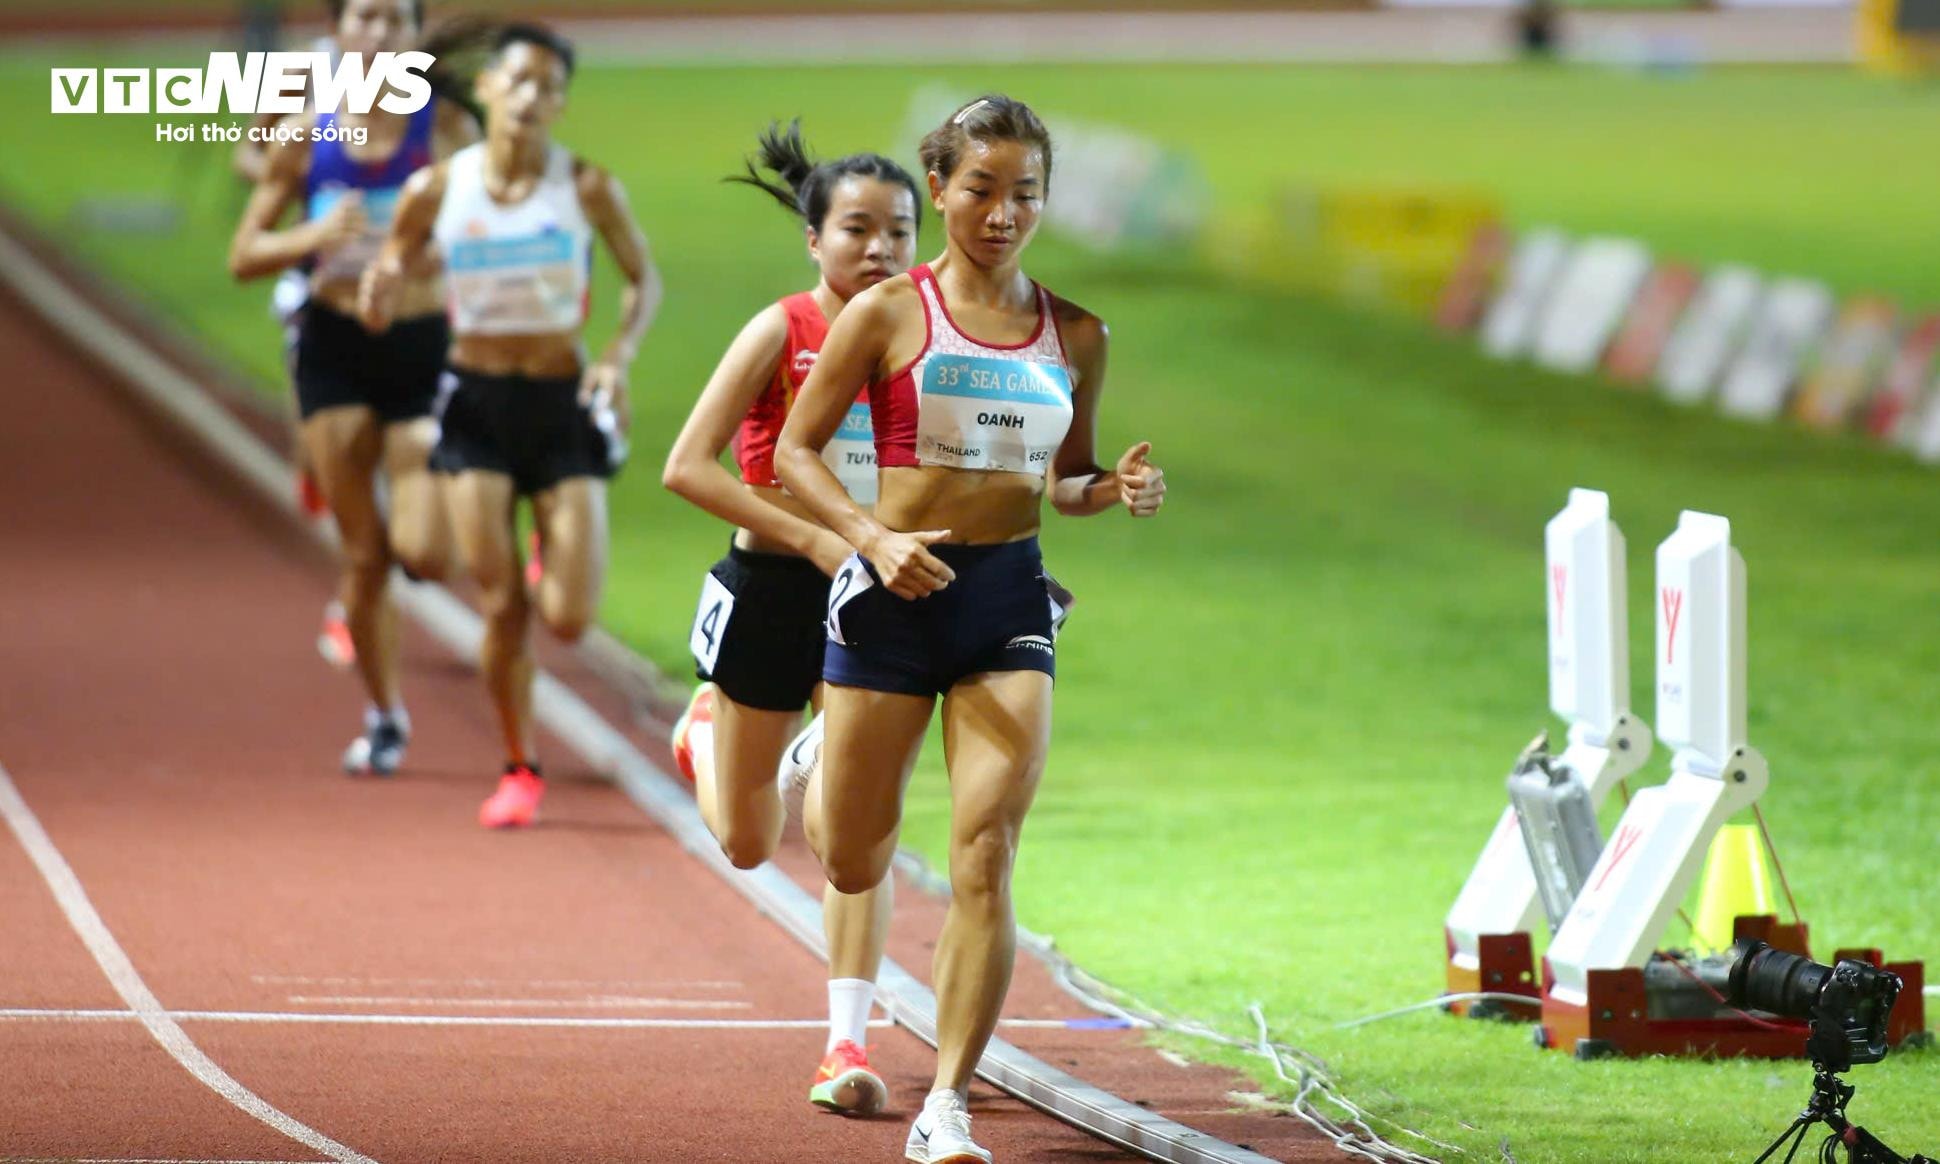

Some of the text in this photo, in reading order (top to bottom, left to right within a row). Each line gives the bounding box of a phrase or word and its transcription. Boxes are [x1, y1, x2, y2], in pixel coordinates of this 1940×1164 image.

[970, 369, 1001, 390] SEA
[1006, 371, 1057, 395] GAM
[977, 412, 1025, 429] OANH
[937, 442, 981, 457] THAILAND
[1029, 450, 1048, 462] 652
[829, 568, 854, 634] 2
[701, 600, 723, 655] 4
